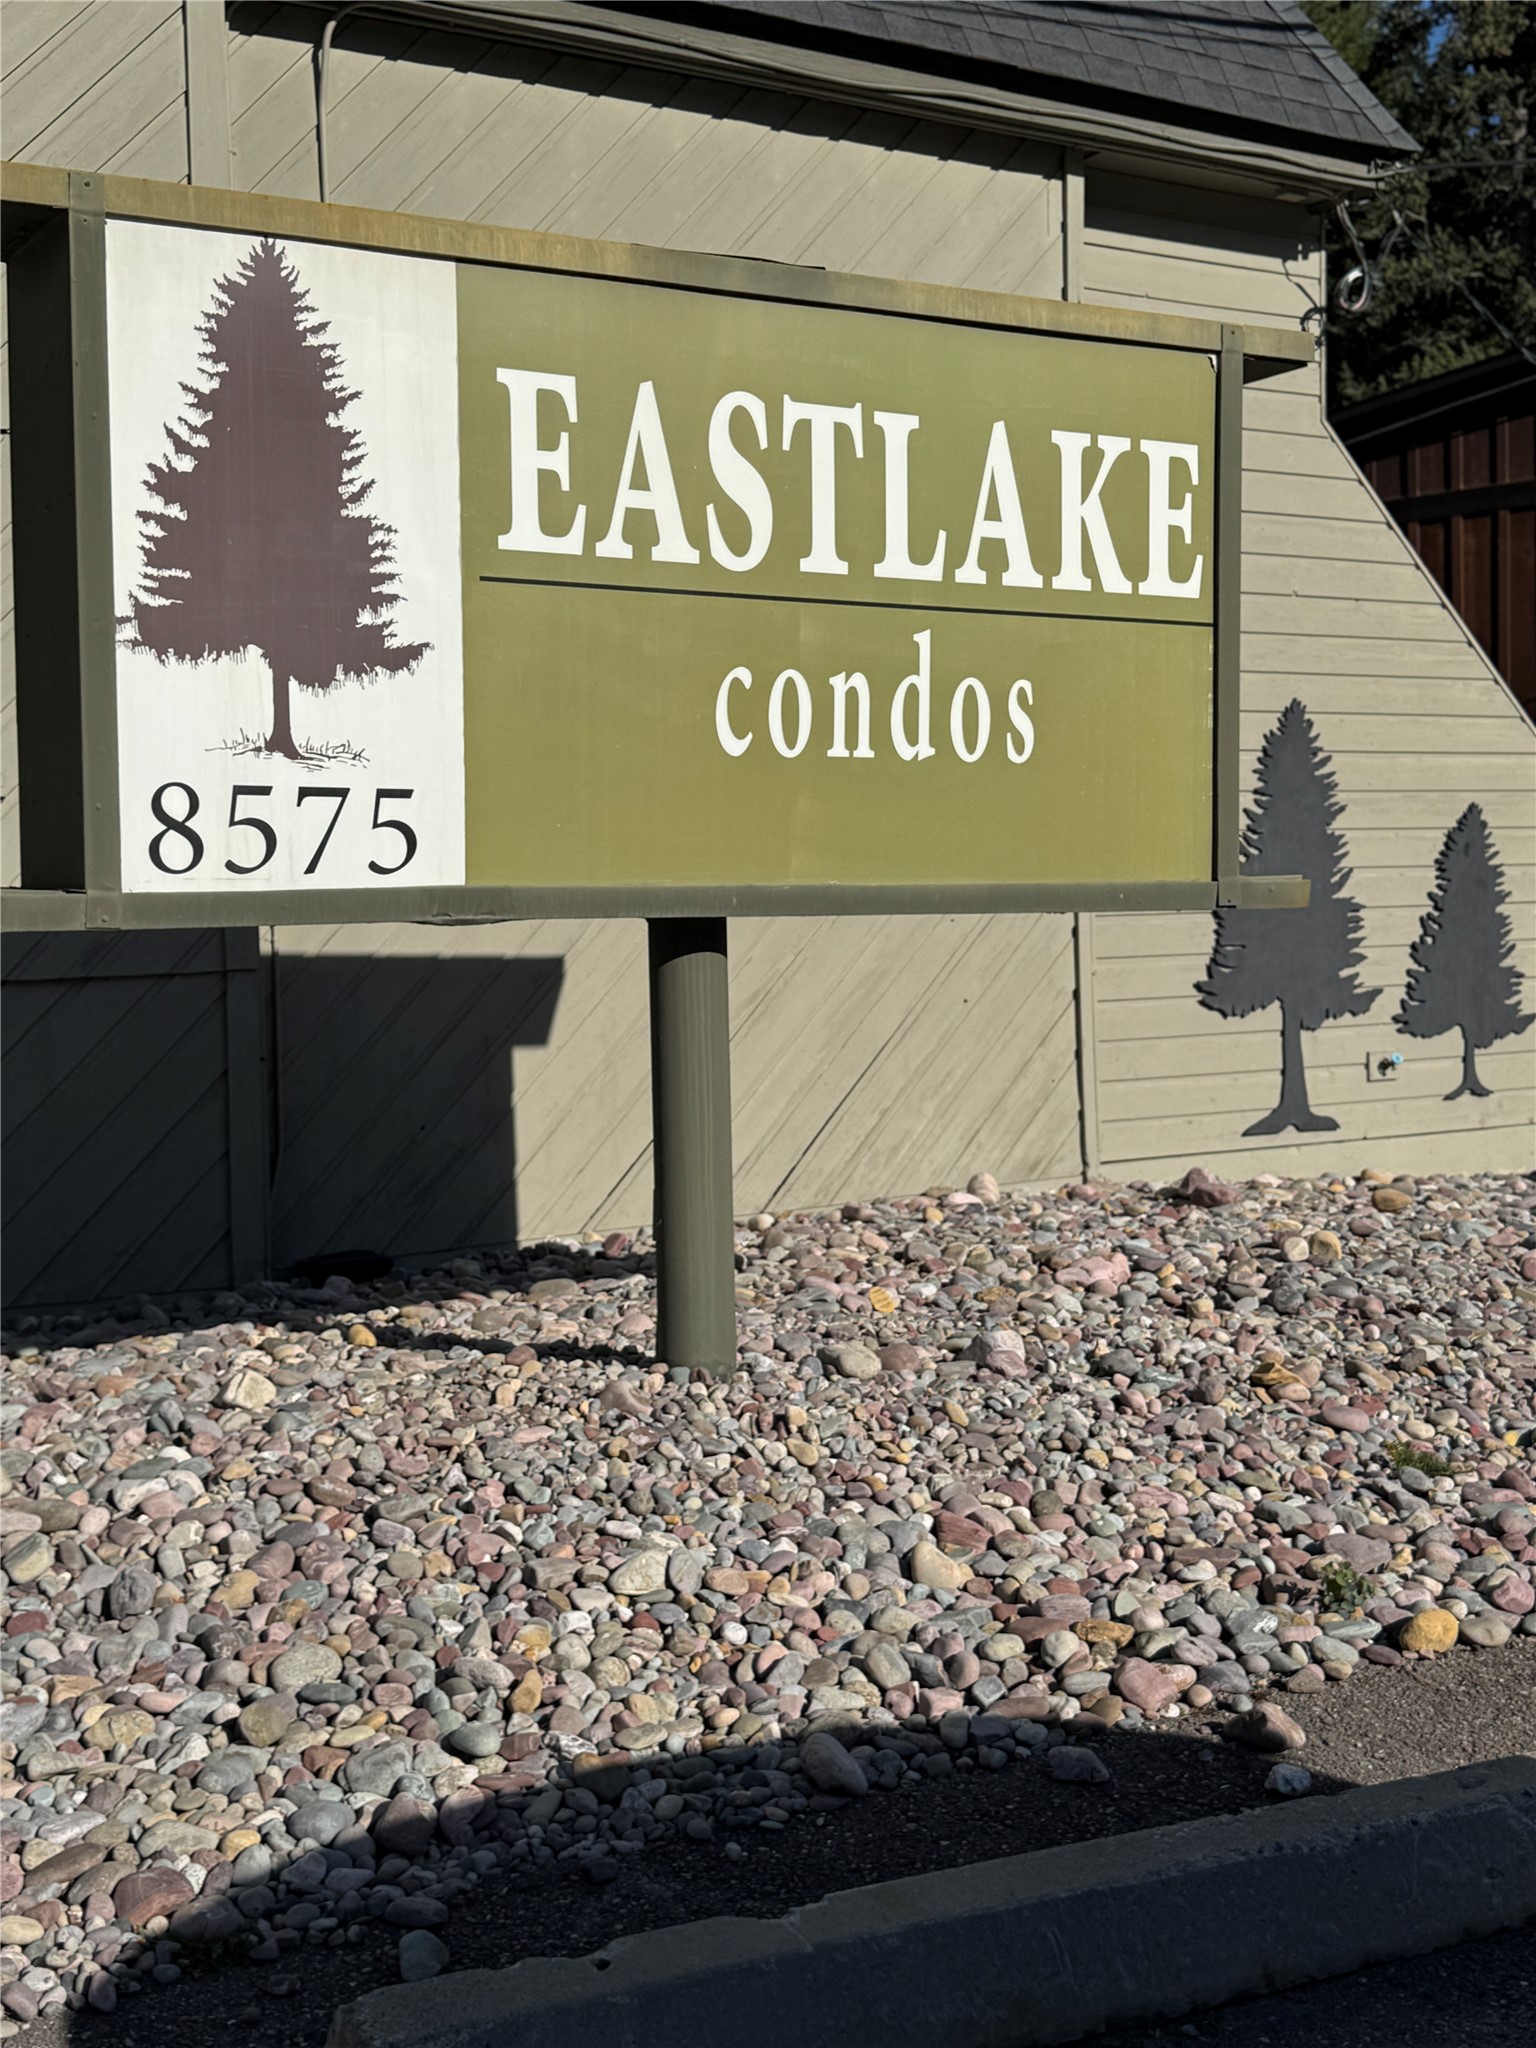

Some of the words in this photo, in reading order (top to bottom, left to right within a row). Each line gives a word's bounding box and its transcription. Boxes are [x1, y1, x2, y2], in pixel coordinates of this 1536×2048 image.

[495, 366, 1204, 600] EASTLAKE
[715, 628, 1036, 764] condos
[148, 782, 419, 876] 8575
